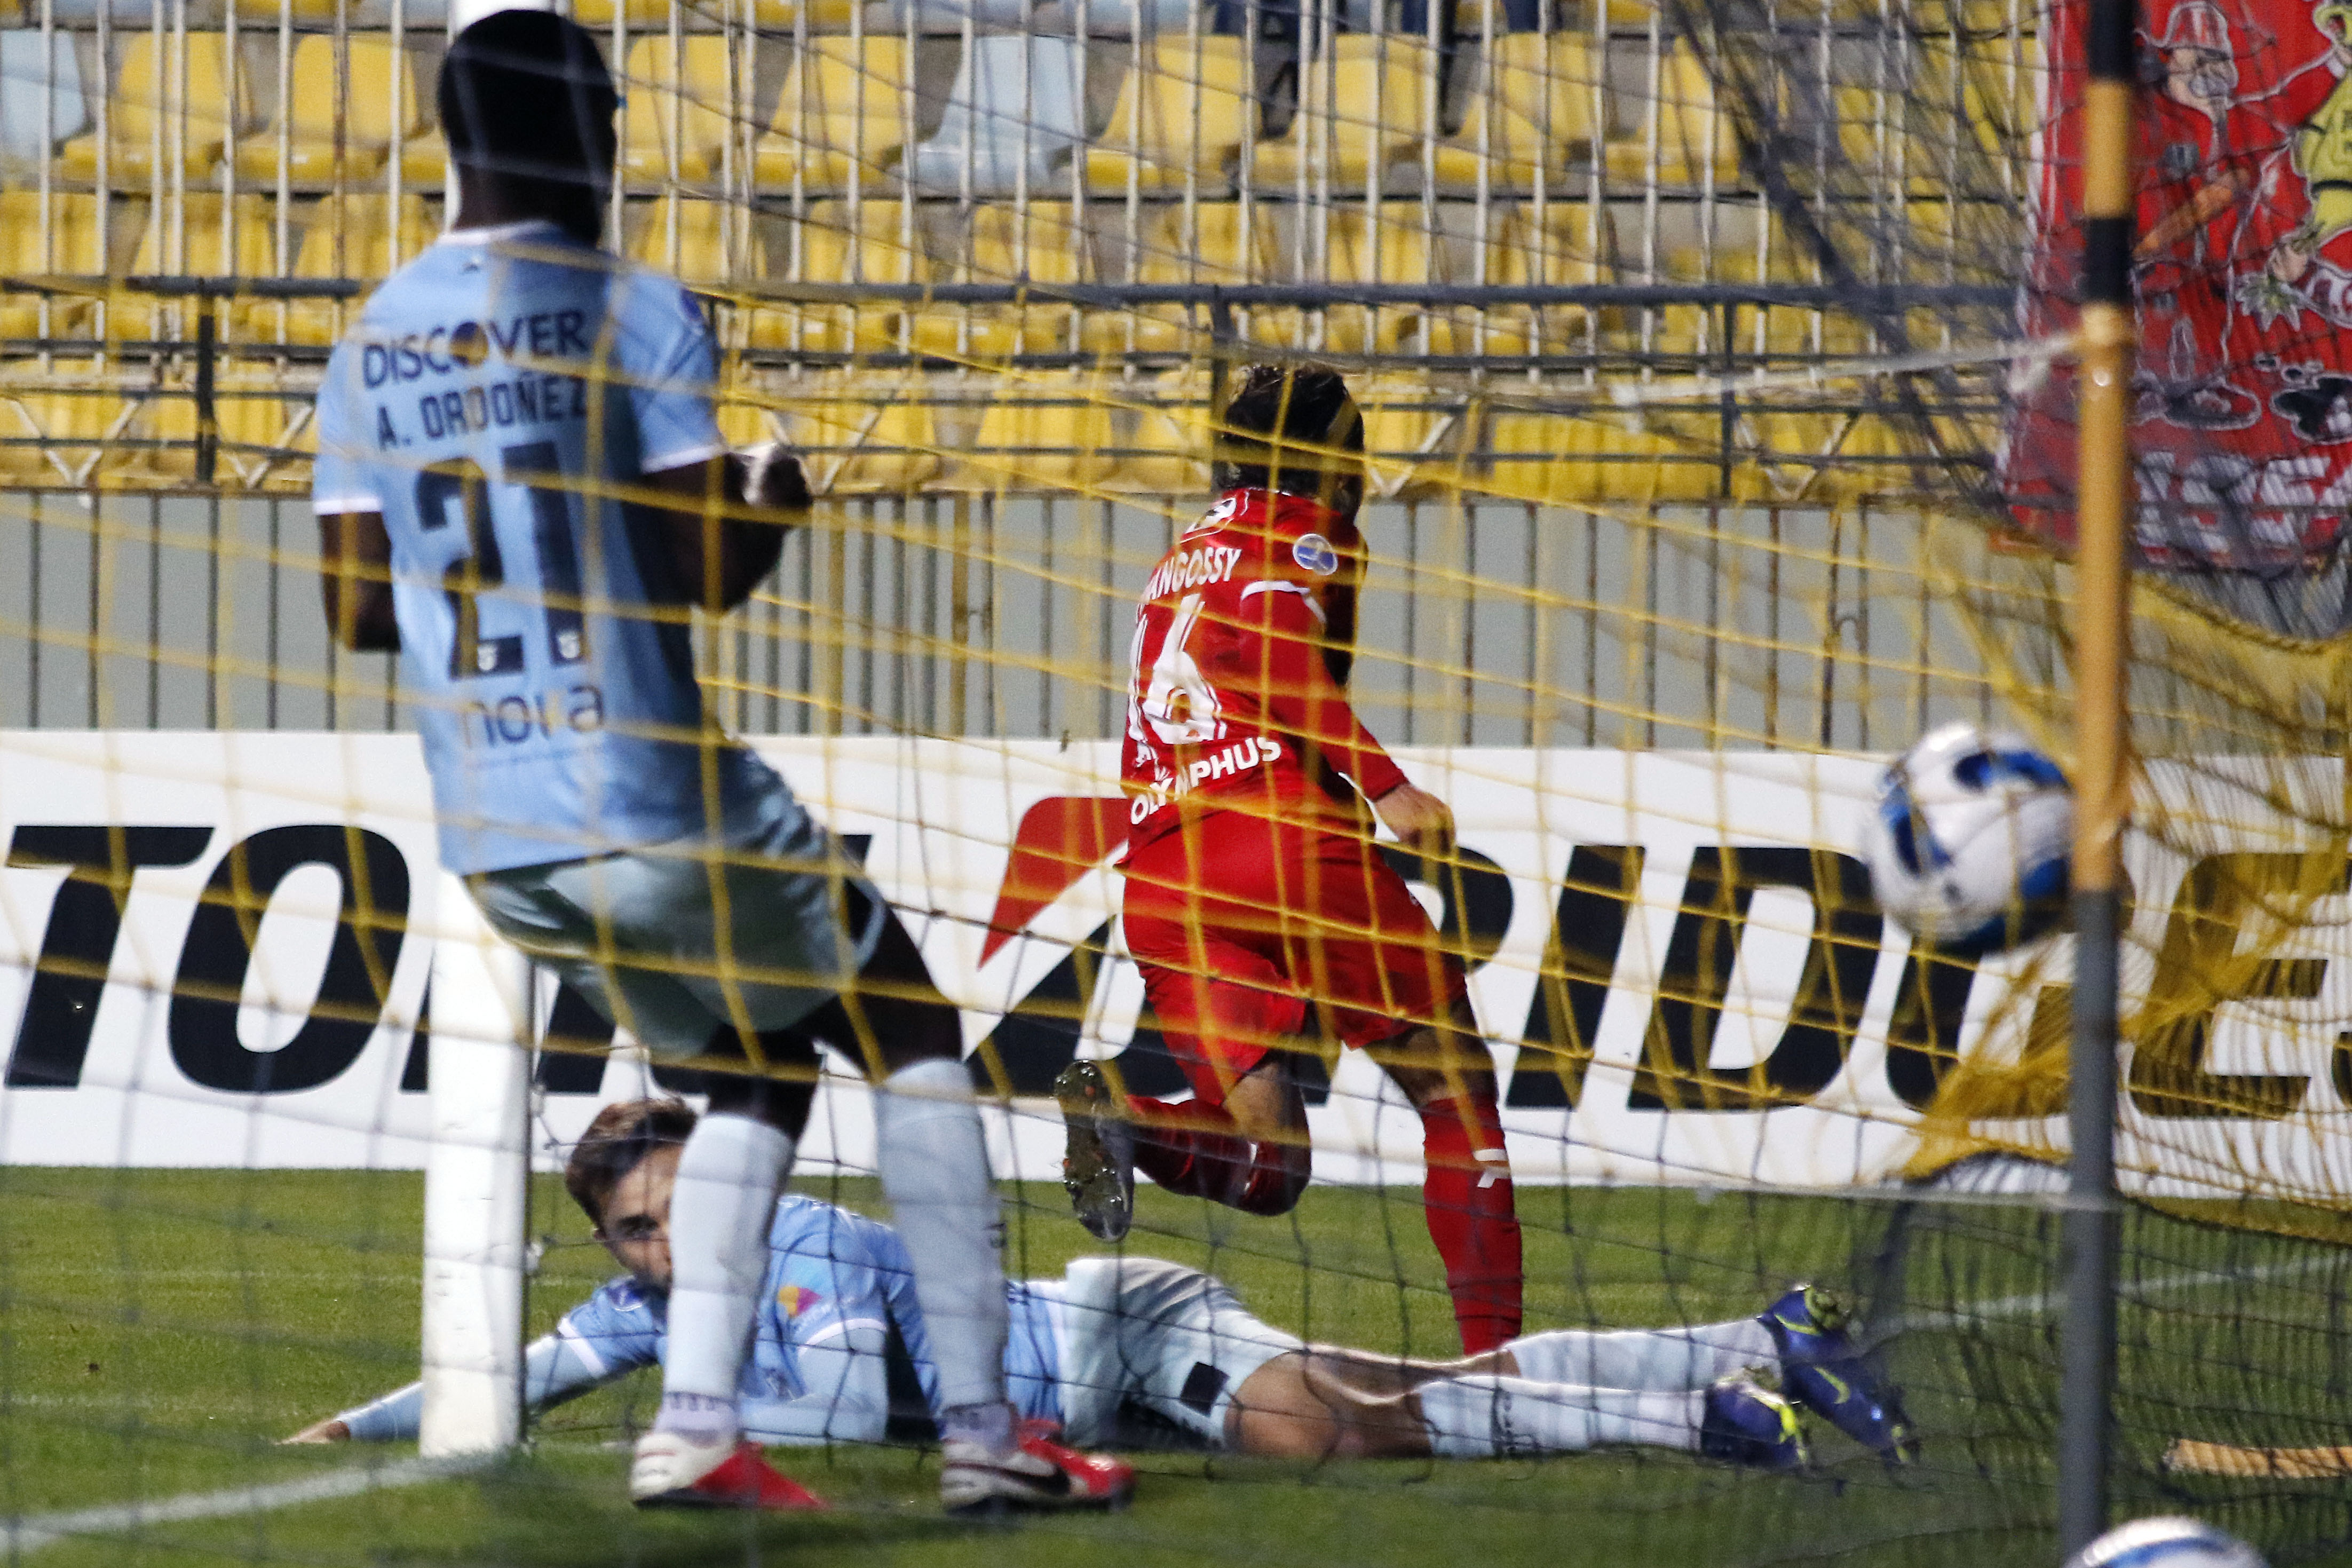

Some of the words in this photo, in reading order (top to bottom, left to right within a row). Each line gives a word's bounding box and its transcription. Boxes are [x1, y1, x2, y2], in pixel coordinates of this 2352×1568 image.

[363, 310, 589, 389] DISCOVER
[377, 406, 412, 452] A.
[414, 441, 593, 681] 21
[1137, 546, 1241, 624] ANGOSSY
[462, 685, 604, 748] nova
